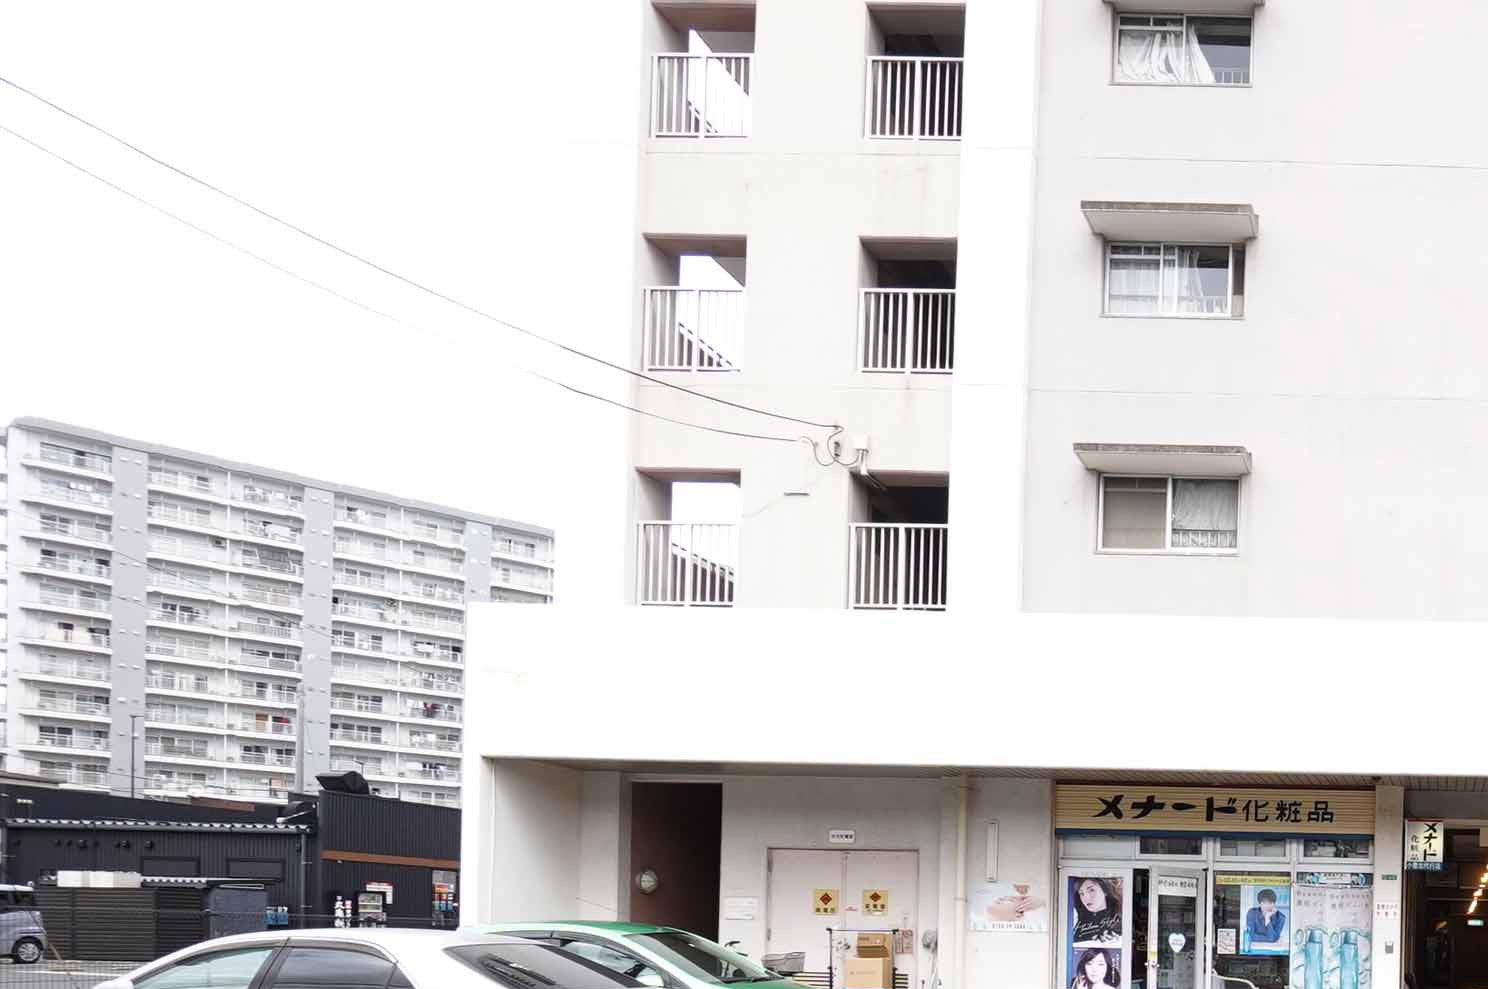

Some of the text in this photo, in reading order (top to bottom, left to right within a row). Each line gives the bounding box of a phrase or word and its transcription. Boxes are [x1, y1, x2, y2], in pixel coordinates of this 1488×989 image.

[1091, 794, 1334, 823] メナード化粧品
[1423, 822, 1438, 861] メナード
